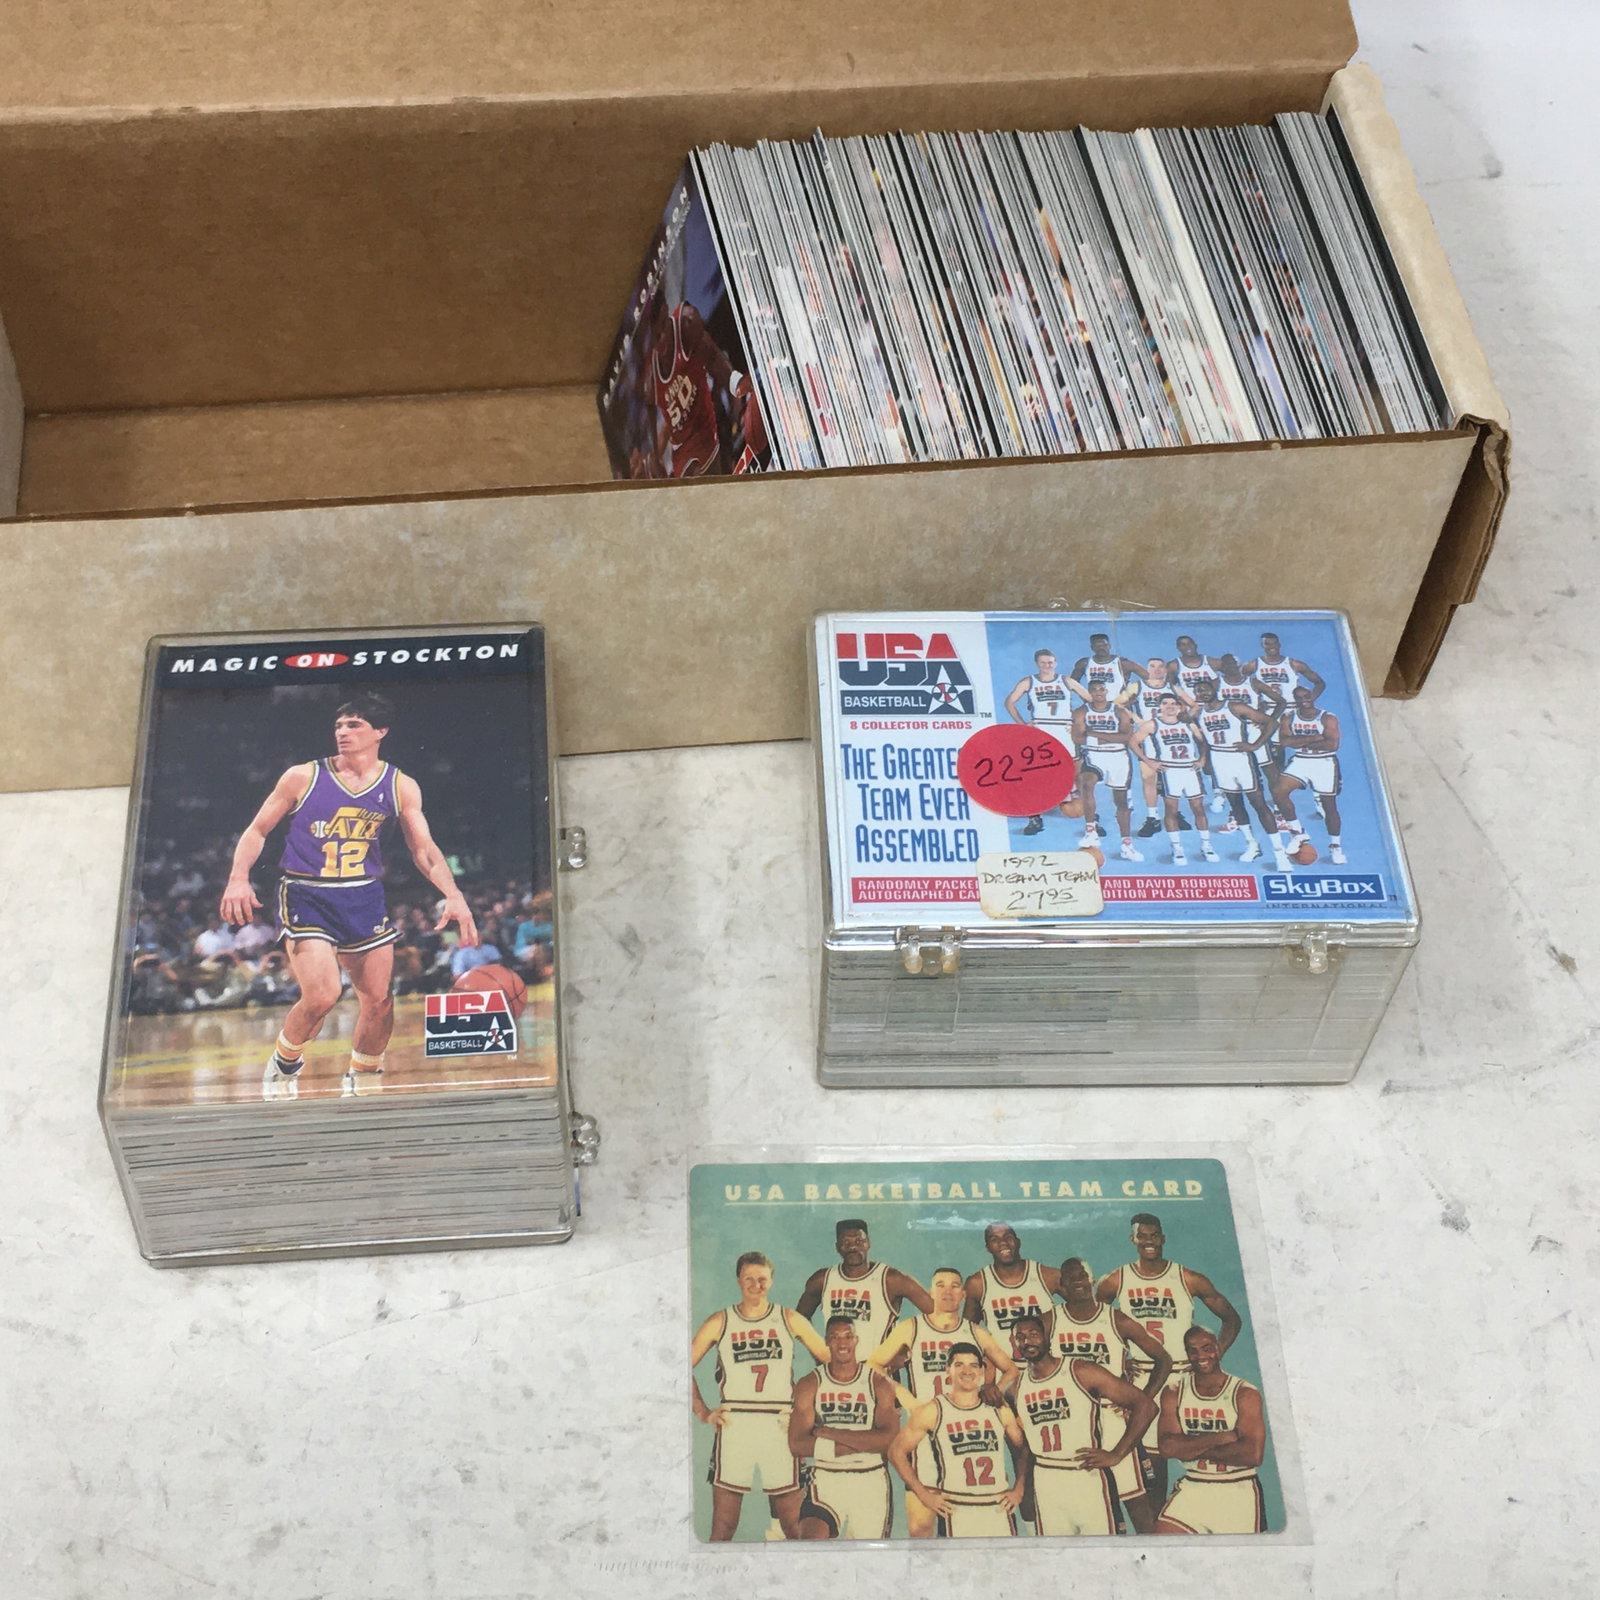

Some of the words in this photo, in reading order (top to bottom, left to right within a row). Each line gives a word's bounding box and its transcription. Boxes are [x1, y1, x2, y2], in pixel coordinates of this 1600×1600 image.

[666, 375, 692, 428] 50
[171, 655, 279, 673] MAGIC
[296, 652, 336, 668] ON
[353, 643, 519, 666] STOCKTON
[836, 632, 972, 687] USA
[844, 695, 926, 708] BASKETBALL
[850, 720, 858, 730] 8
[861, 720, 929, 730] COLLECTOR
[934, 720, 973, 730] CARDS
[882, 743, 962, 780] GREATE
[1169, 745, 1189, 760] 12
[857, 783, 912, 821] TEAM
[919, 783, 971, 821] EVER
[855, 824, 980, 863] ASSEMBLED
[320, 841, 370, 878] 12
[1003, 855, 1059, 869] 1992
[858, 879, 930, 890] RANDOMLY
[1104, 878, 1125, 889] AND
[1136, 878, 1175, 889] DAVID
[1181, 877, 1250, 888] ROBINSON
[981, 872, 1048, 885] DREAM
[1268, 873, 1377, 898] SkyBox
[858, 890, 954, 900] AUTOGRAPHED
[1103, 888, 1147, 899] DITION
[1151, 888, 1203, 899] PLASTIC
[1208, 887, 1252, 898] CARDS
[426, 991, 514, 1035] USA
[428, 1039, 483, 1051] BASKETBALL
[725, 1184, 785, 1200] USA
[804, 1182, 1001, 1200] BASKETBALL
[1020, 1180, 1103, 1198] TEAM
[1122, 1180, 1203, 1197] CARD
[830, 1288, 871, 1310] USA
[991, 1294, 1043, 1319] USA
[1127, 1286, 1176, 1308] USA
[731, 1328, 782, 1351] USA
[921, 1340, 954, 1361] US
[1058, 1332, 1110, 1353] USA
[751, 1364, 769, 1393] 7
[820, 1392, 868, 1413] USA
[1024, 1387, 1069, 1414] USA
[946, 1418, 998, 1443] USA
[1184, 1407, 1228, 1431] USA
[1040, 1423, 1062, 1453] 11
[963, 1455, 996, 1487] 12
